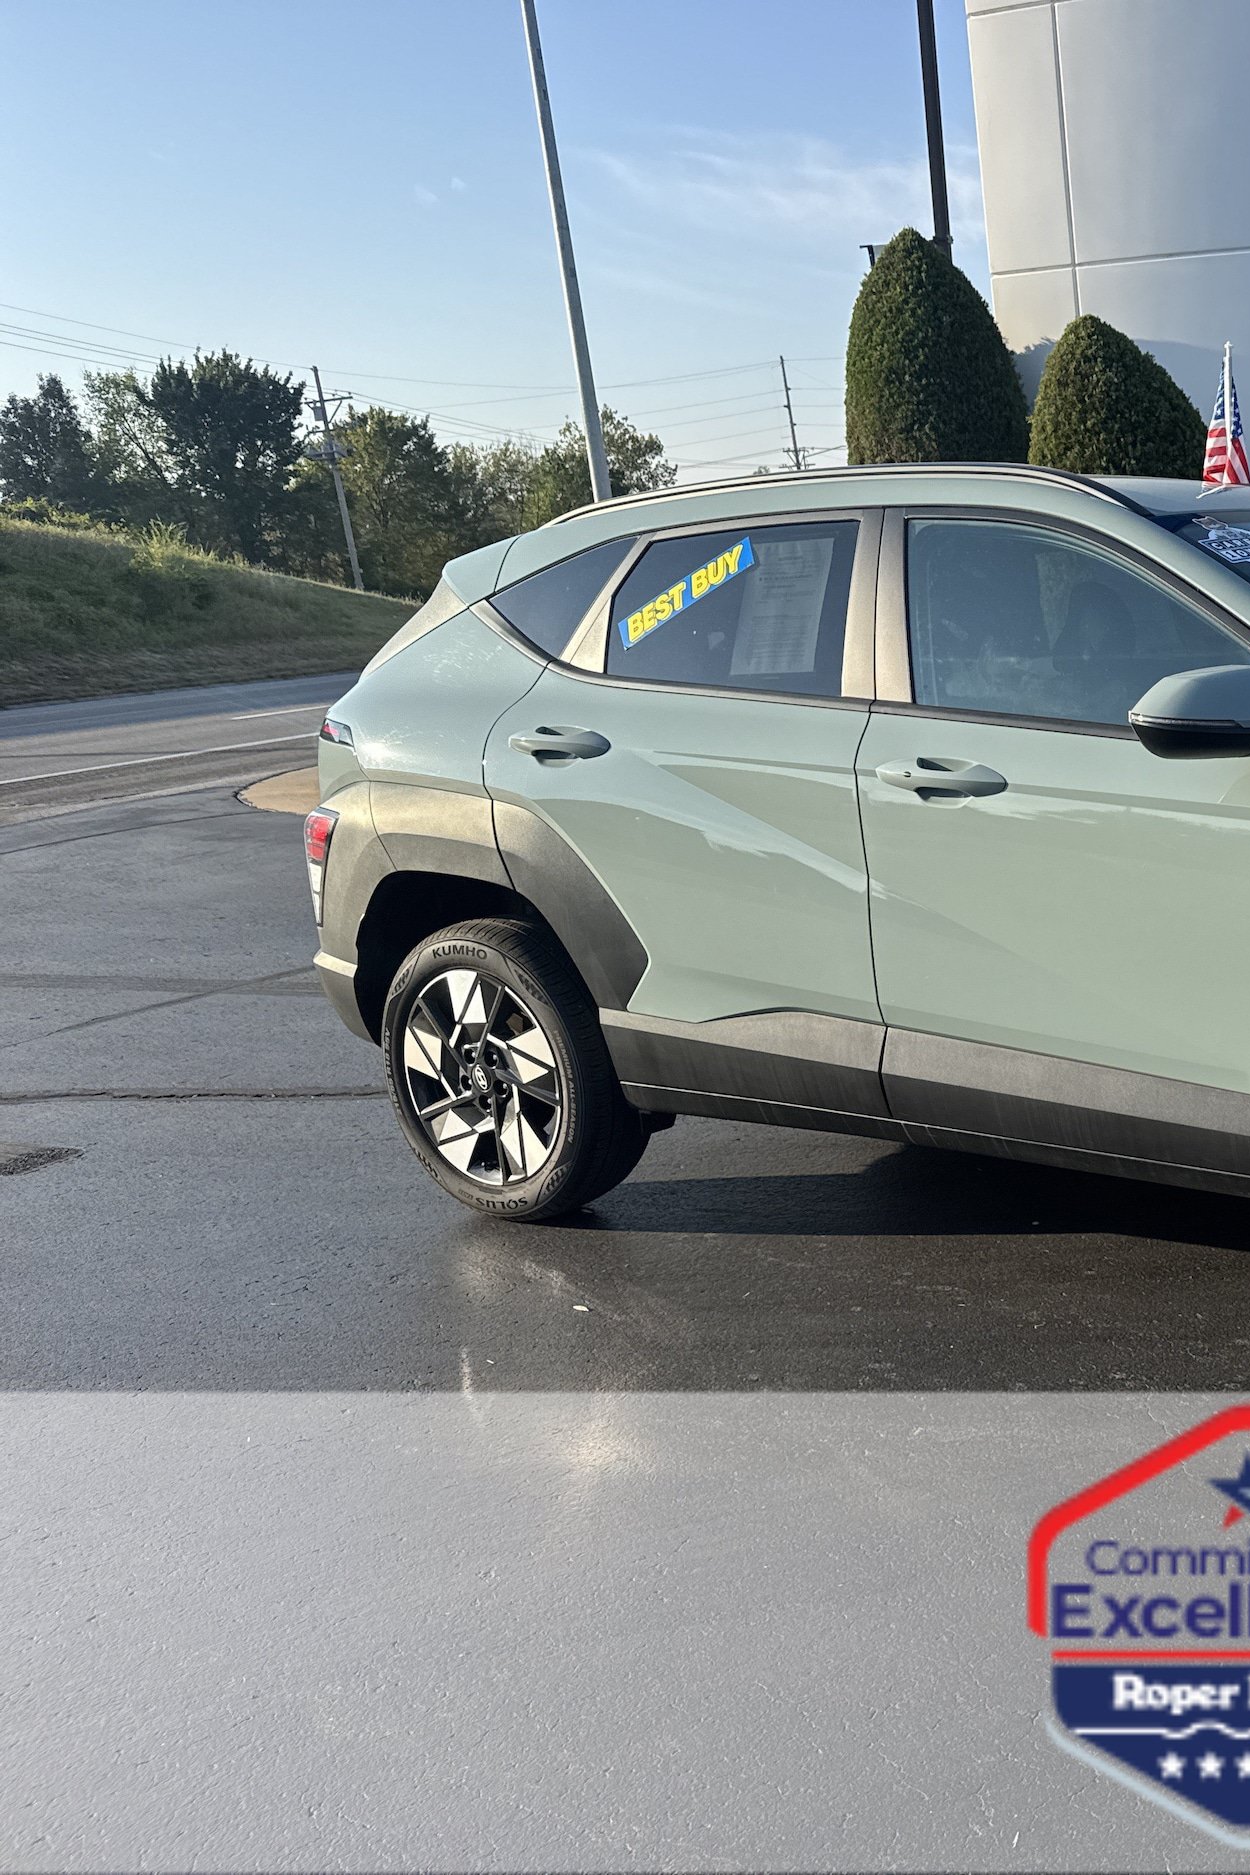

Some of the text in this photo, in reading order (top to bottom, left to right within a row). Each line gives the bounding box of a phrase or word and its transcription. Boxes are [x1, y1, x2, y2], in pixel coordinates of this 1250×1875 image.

[627, 581, 687, 644] BEST
[690, 543, 744, 599] BUY
[432, 944, 487, 961] KUMHO
[553, 1030, 577, 1144] PREMIUM ALL-SEASON
[475, 1196, 529, 1211] SOLUS
